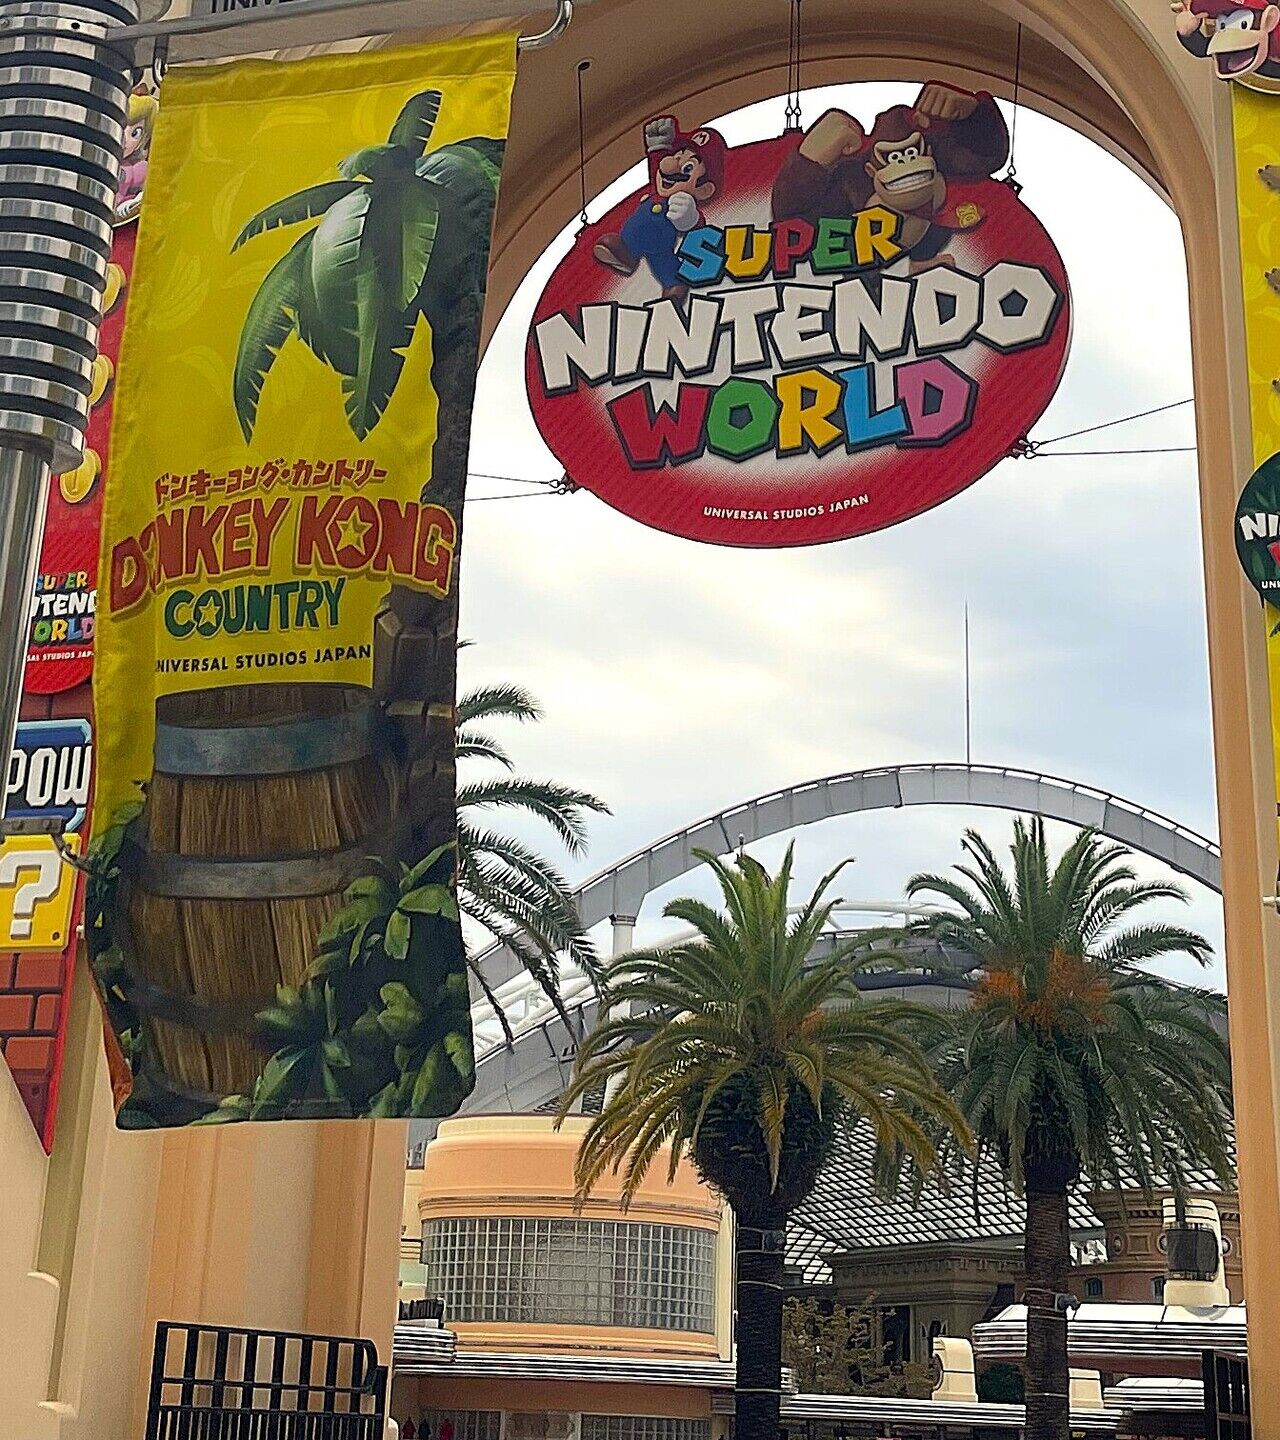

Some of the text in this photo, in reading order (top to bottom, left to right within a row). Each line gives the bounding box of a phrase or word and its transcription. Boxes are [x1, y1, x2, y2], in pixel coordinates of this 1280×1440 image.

[678, 205, 903, 286] SUPER
[535, 262, 1062, 395] NINTENDO
[608, 356, 977, 469] WORLD
[704, 494, 869, 520] UNIVERSAL STUDIOS JAPAN
[298, 495, 456, 591] KONG
[33, 616, 94, 643] ORLD
[165, 578, 345, 638] COUNTRY
[236, 651, 307, 668] STUDIOS
[314, 645, 372, 663] JAPAN
